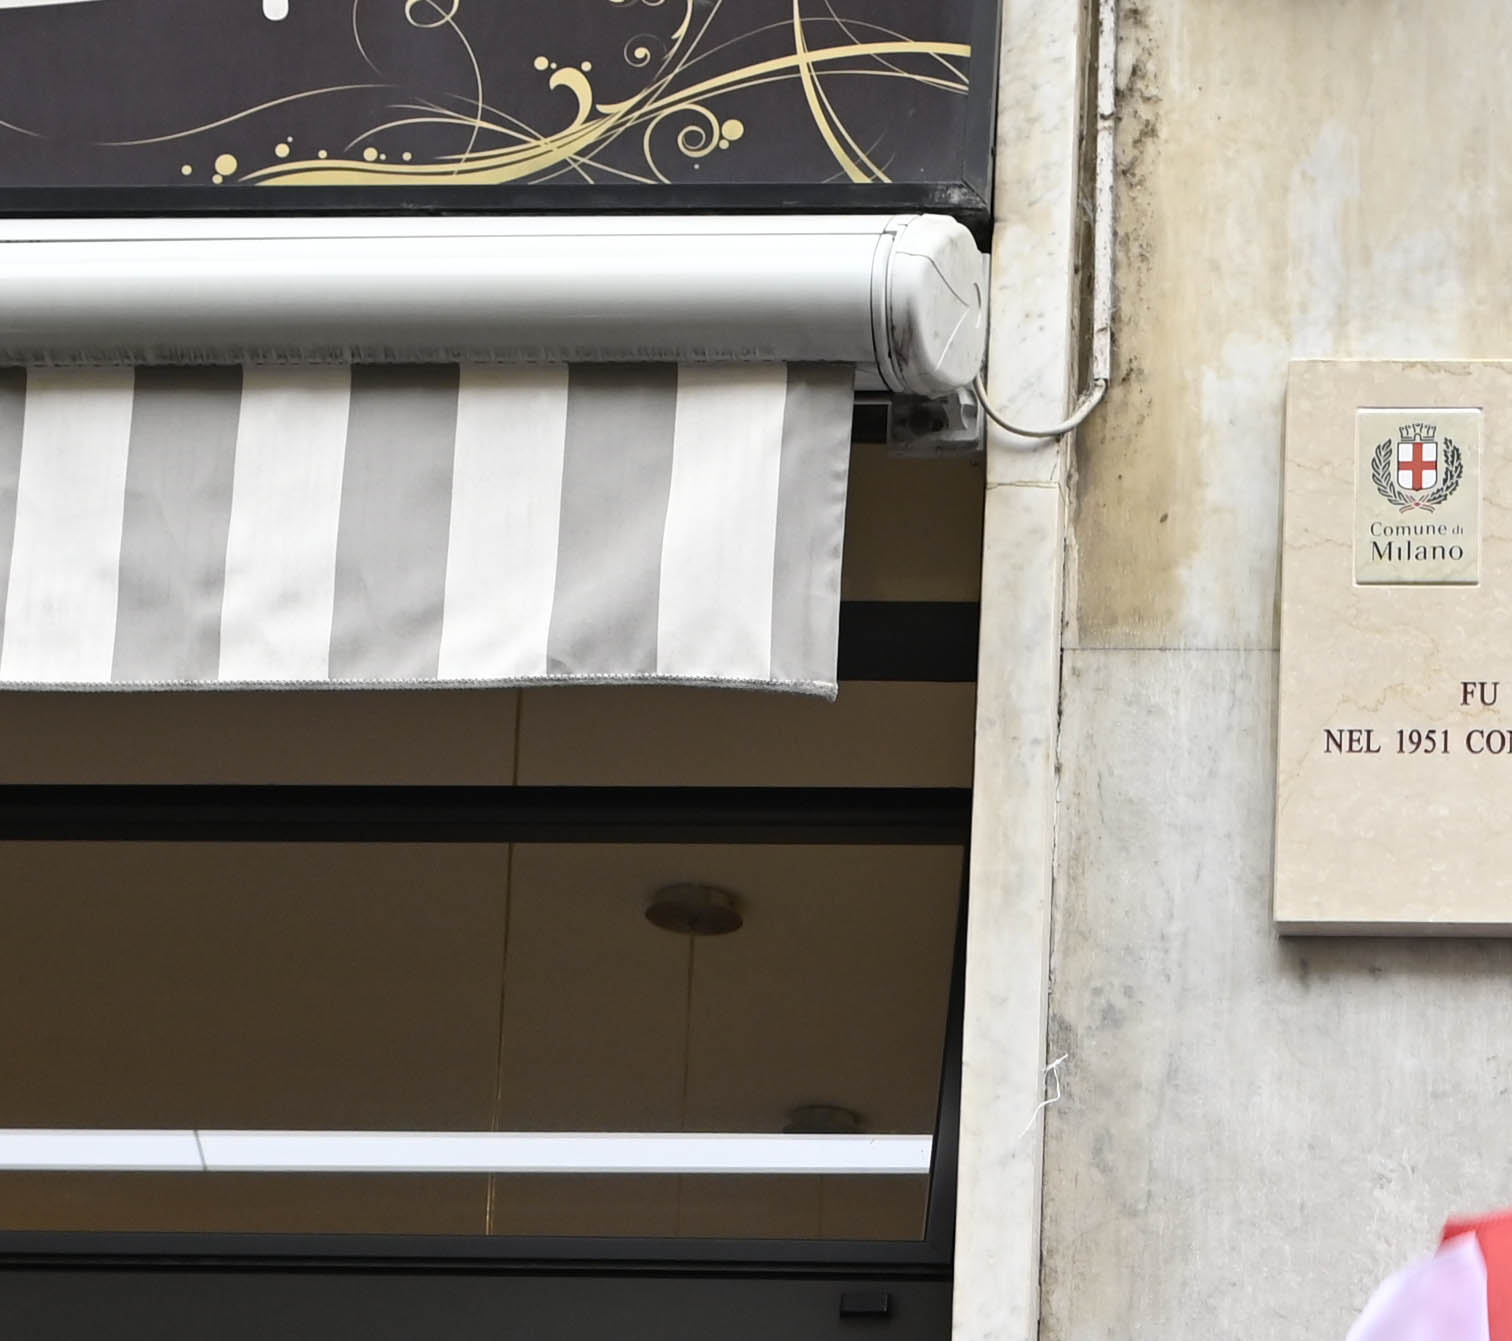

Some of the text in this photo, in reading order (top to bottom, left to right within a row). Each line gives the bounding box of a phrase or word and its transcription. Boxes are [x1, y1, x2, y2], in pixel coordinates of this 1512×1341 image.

[1370, 522, 1464, 537] Comune di
[1371, 540, 1464, 561] Milano
[1460, 681, 1500, 707] FU
[1323, 728, 1382, 754] NEL
[1396, 728, 1450, 755] 1951
